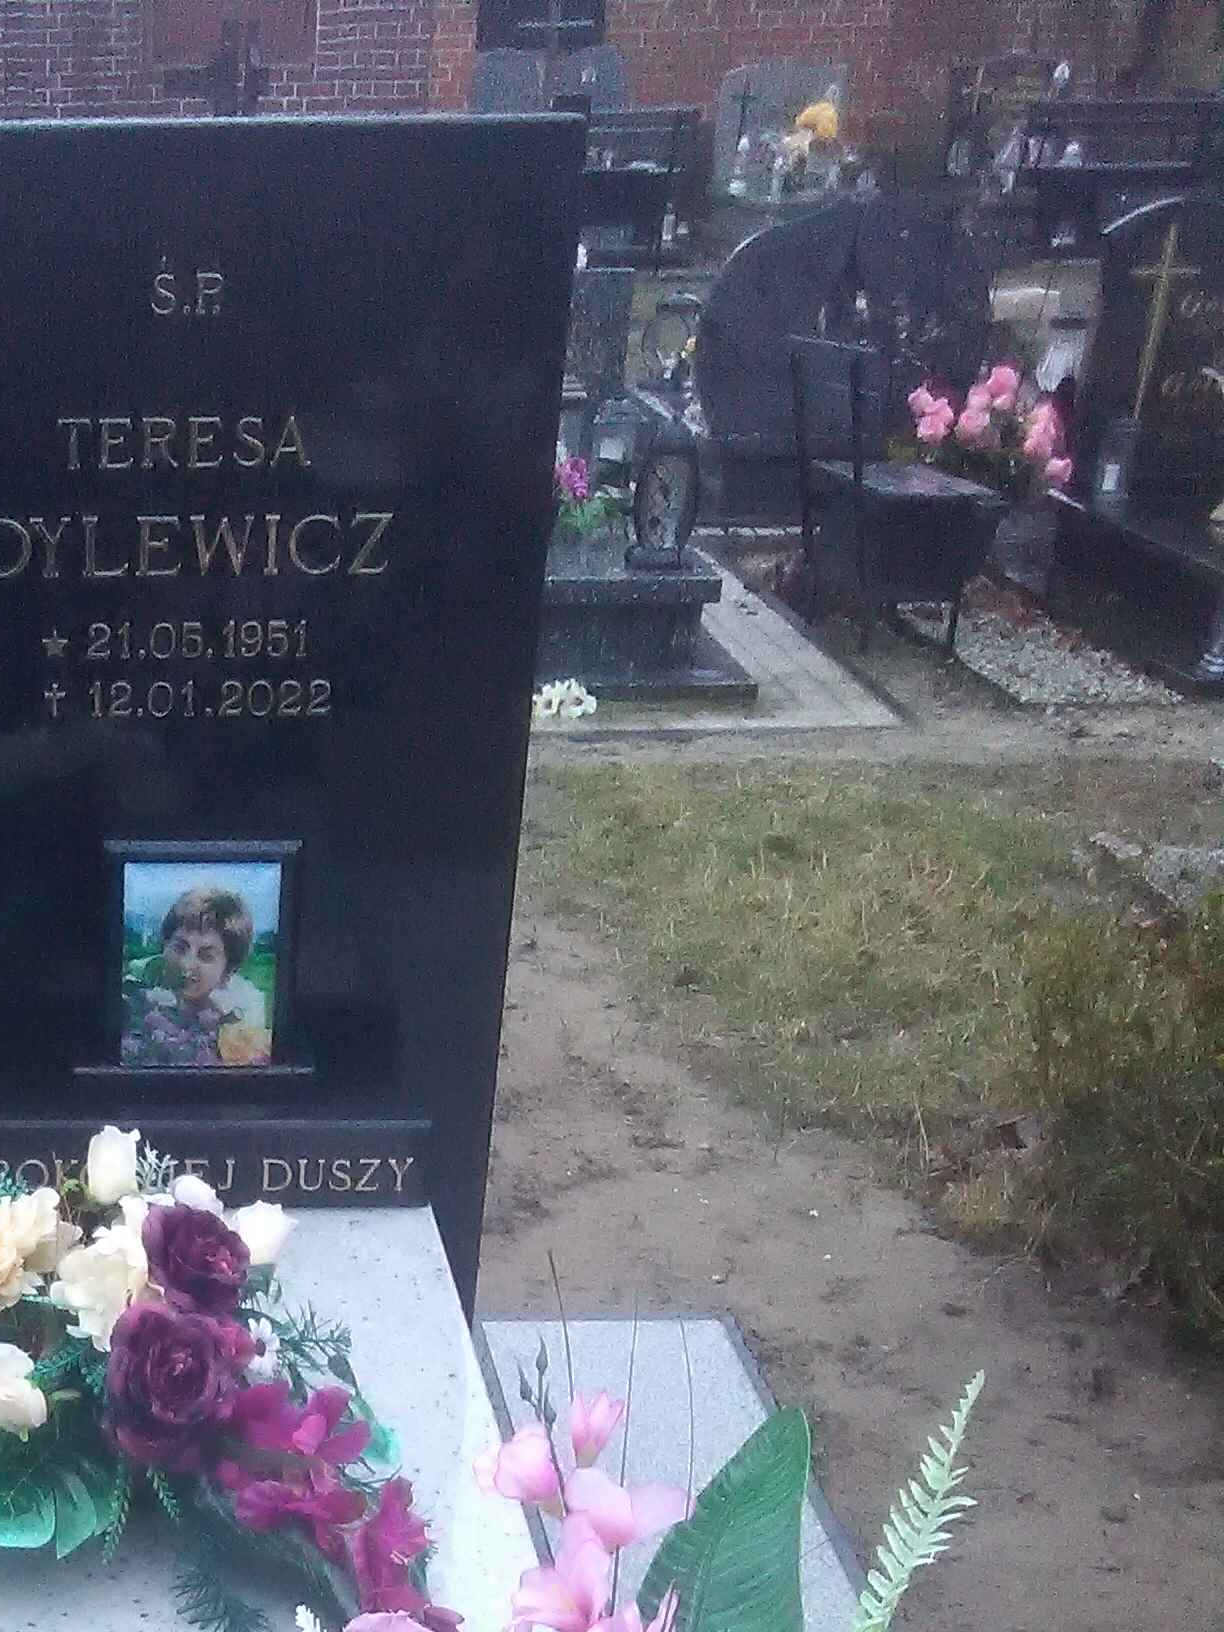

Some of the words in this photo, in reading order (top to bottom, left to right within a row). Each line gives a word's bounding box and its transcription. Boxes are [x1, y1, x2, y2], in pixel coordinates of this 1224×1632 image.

[57, 415, 312, 470] TERESA
[87, 619, 310, 661] 21.05.1951
[88, 679, 333, 718] 12.01.2022
[261, 1156, 415, 1192] DUSZY
